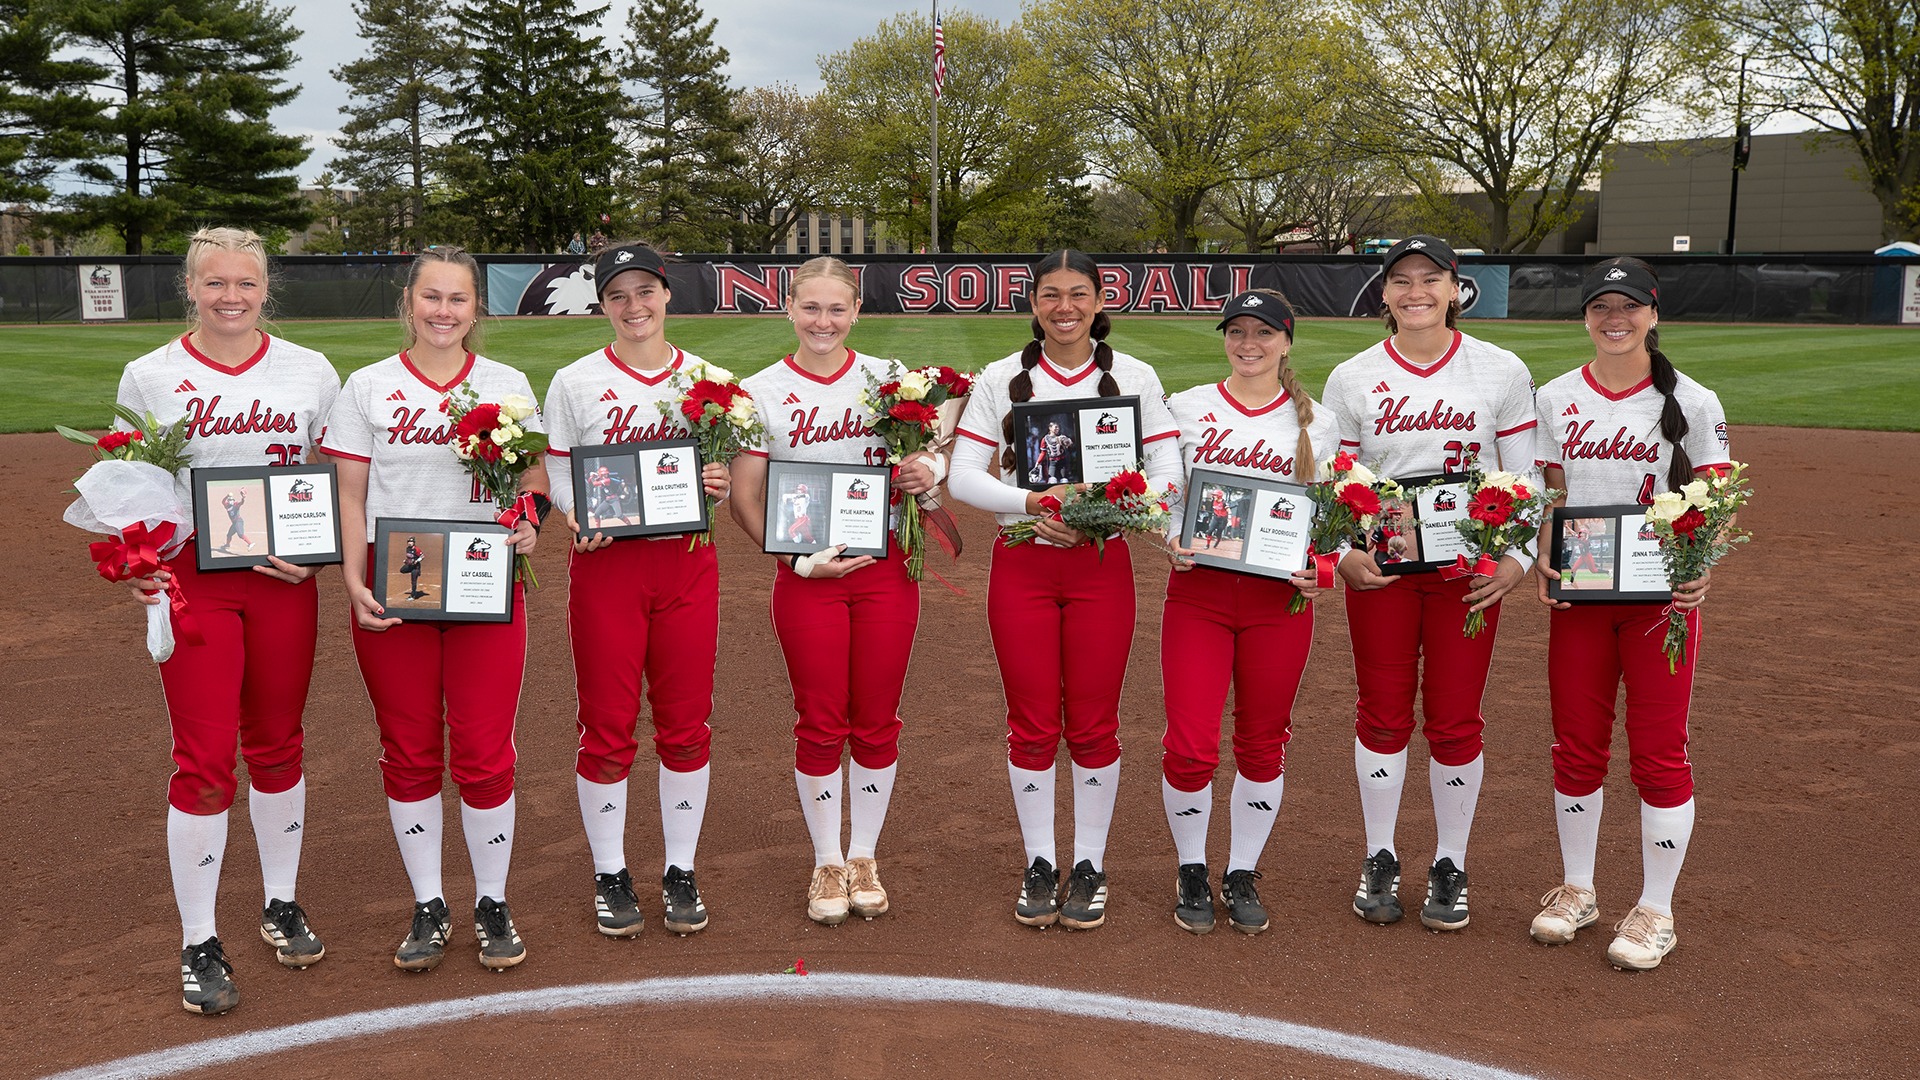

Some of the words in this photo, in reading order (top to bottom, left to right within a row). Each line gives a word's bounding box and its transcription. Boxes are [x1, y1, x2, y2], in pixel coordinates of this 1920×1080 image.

[896, 264, 1255, 312] SOFBAL
[185, 395, 298, 440] Huskies
[1374, 396, 1477, 436] Huskies
[387, 406, 459, 445] Husk
[1095, 424, 1118, 433] NIU
[1562, 420, 1660, 463] Huskies
[1193, 427, 1294, 476] Huskies
[656, 464, 679, 474] NIU
[288, 492, 313, 502] NIU
[847, 490, 868, 500] NIU
[1433, 501, 1456, 511] NIU
[1270, 508, 1293, 520] NIU
[1425, 521, 1447, 529] DANIELLE
[1271, 528, 1298, 538] RODRIGUEZ
[465, 551, 490, 561] NIU
